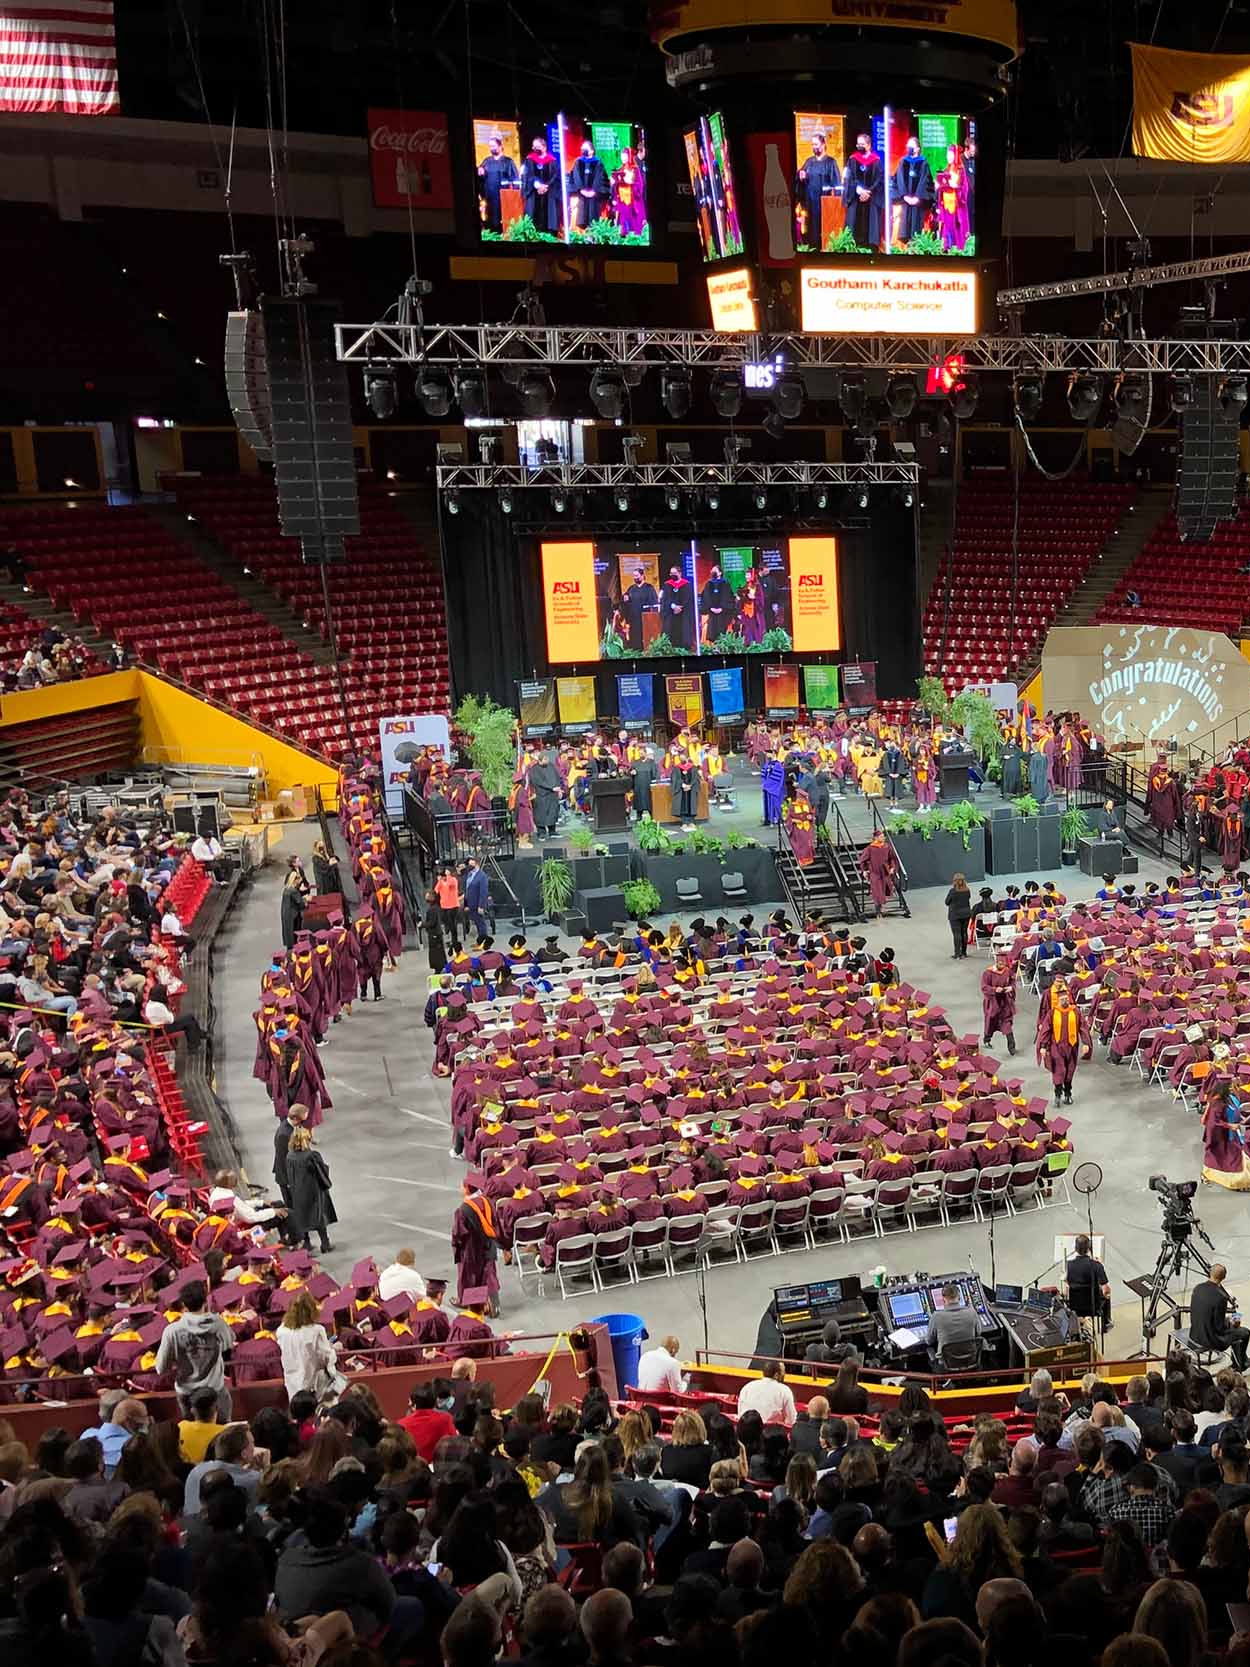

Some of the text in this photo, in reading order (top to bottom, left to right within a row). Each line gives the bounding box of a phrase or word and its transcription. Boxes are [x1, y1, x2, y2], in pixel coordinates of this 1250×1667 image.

[807, 277, 968, 292] Gouthami Kanchukatla
[836, 298, 943, 312] Computer Science
[553, 581, 580, 594] ASU
[799, 575, 822, 587] ASU
[1089, 657, 1223, 722] Congratulations
[384, 720, 416, 735] ASU
